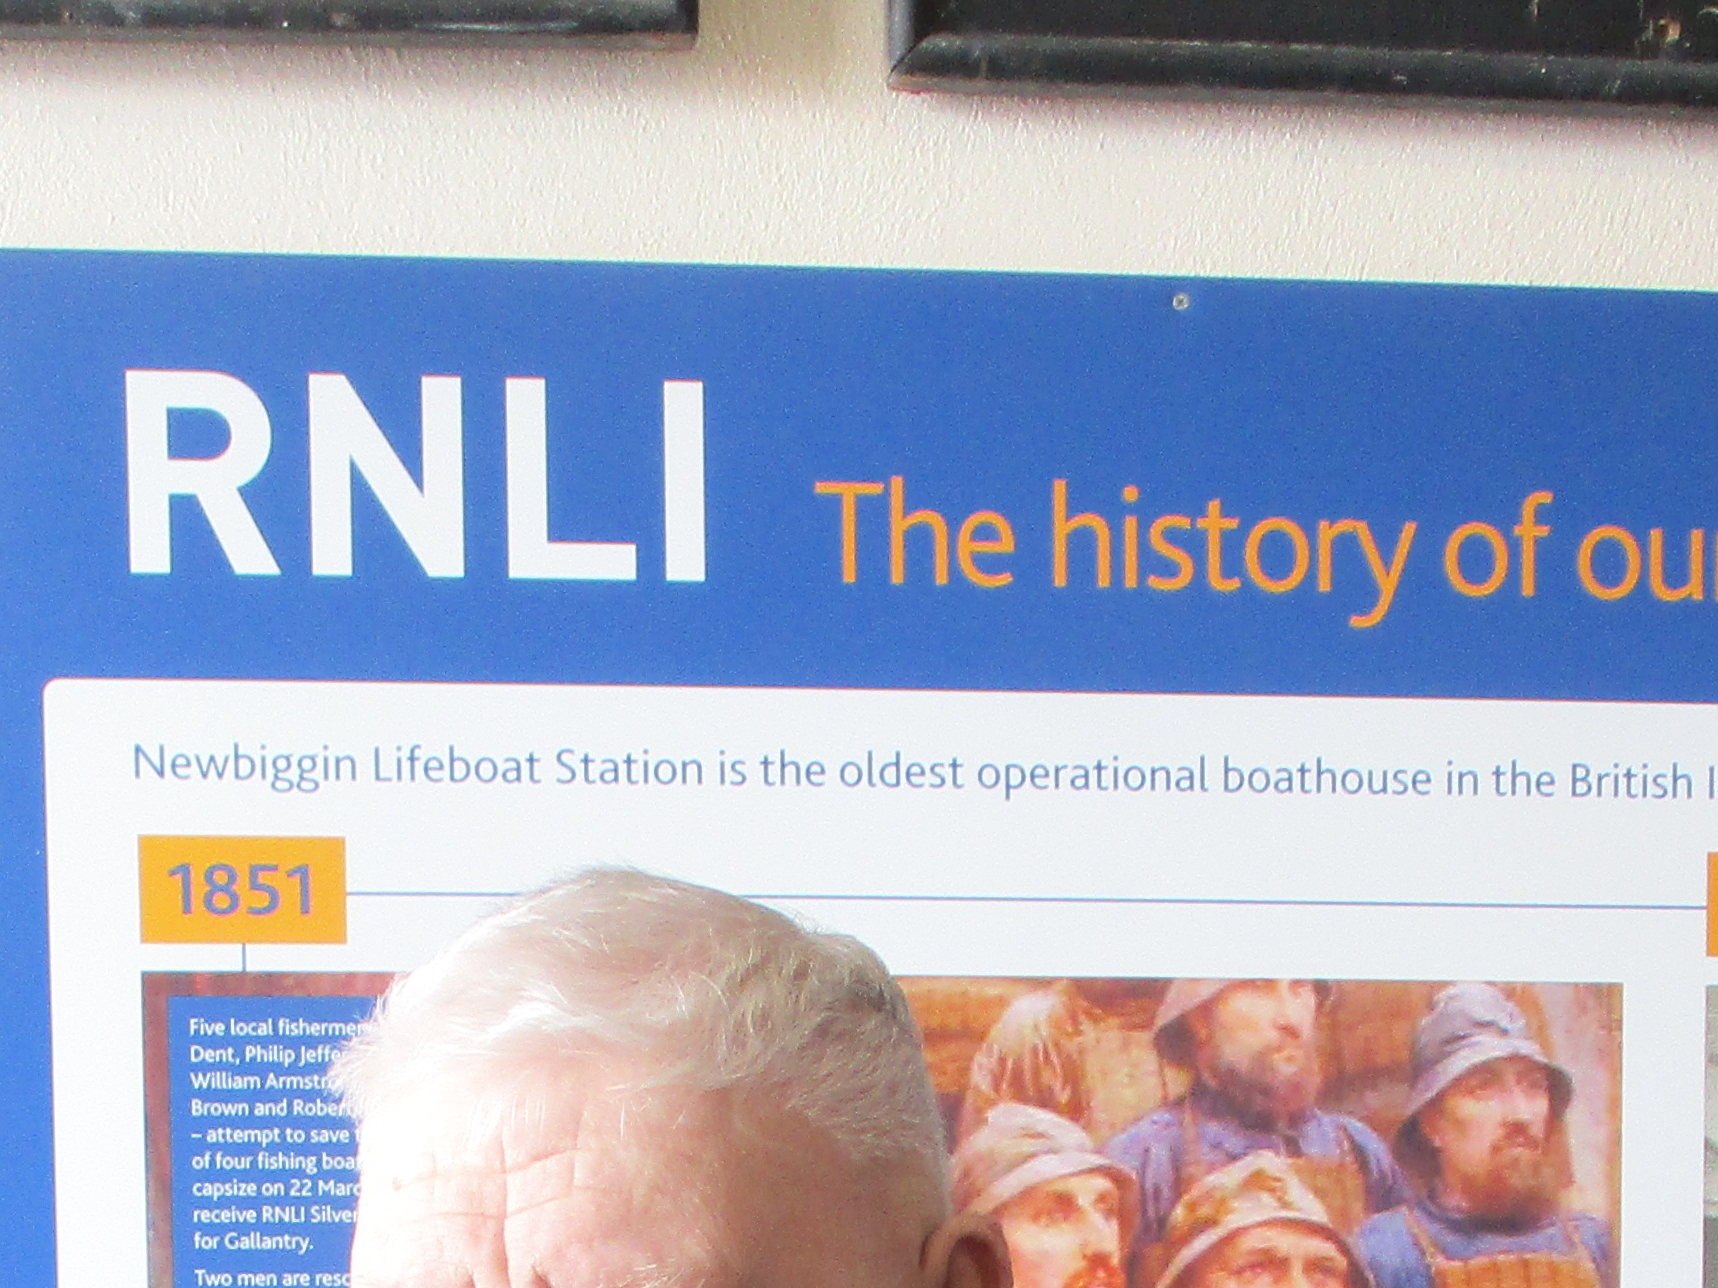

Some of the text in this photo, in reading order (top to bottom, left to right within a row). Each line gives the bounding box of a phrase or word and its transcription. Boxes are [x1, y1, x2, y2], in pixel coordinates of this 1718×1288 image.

[124, 367, 705, 581] RNLI
[813, 474, 1015, 588] The
[1052, 478, 1417, 628] history
[1443, 490, 1554, 597] of
[134, 742, 356, 792] Newbiggin
[374, 744, 540, 783] Lifeboat
[556, 748, 702, 784] Station
[719, 749, 746, 785] is
[759, 748, 826, 786] the
[839, 749, 964, 788] oldest
[977, 754, 1208, 800] operational
[1223, 754, 1432, 795] boathouse
[1447, 759, 1478, 795] in
[1491, 758, 1555, 796] the
[1571, 761, 1692, 799] British
[168, 863, 311, 915] 1851
[189, 1017, 225, 1035] Five
[230, 1017, 273, 1035] local
[190, 1044, 239, 1064] Dent,
[245, 1044, 295, 1067] Philip
[189, 1070, 260, 1089] William
[191, 1097, 287, 1116] Brown and
[206, 1127, 350, 1147] attempt to save
[191, 1150, 317, 1175] of four fishing
[192, 1178, 257, 1201] capsize
[261, 1182, 284, 1196] on
[289, 1178, 311, 1196] 22
[193, 1205, 257, 1223] receive
[262, 1204, 305, 1223] RNLI
[193, 1230, 313, 1254] for Gallantry.
[194, 1268, 232, 1286] Two
[237, 1272, 277, 1286] men
[281, 1272, 310, 1286] are
